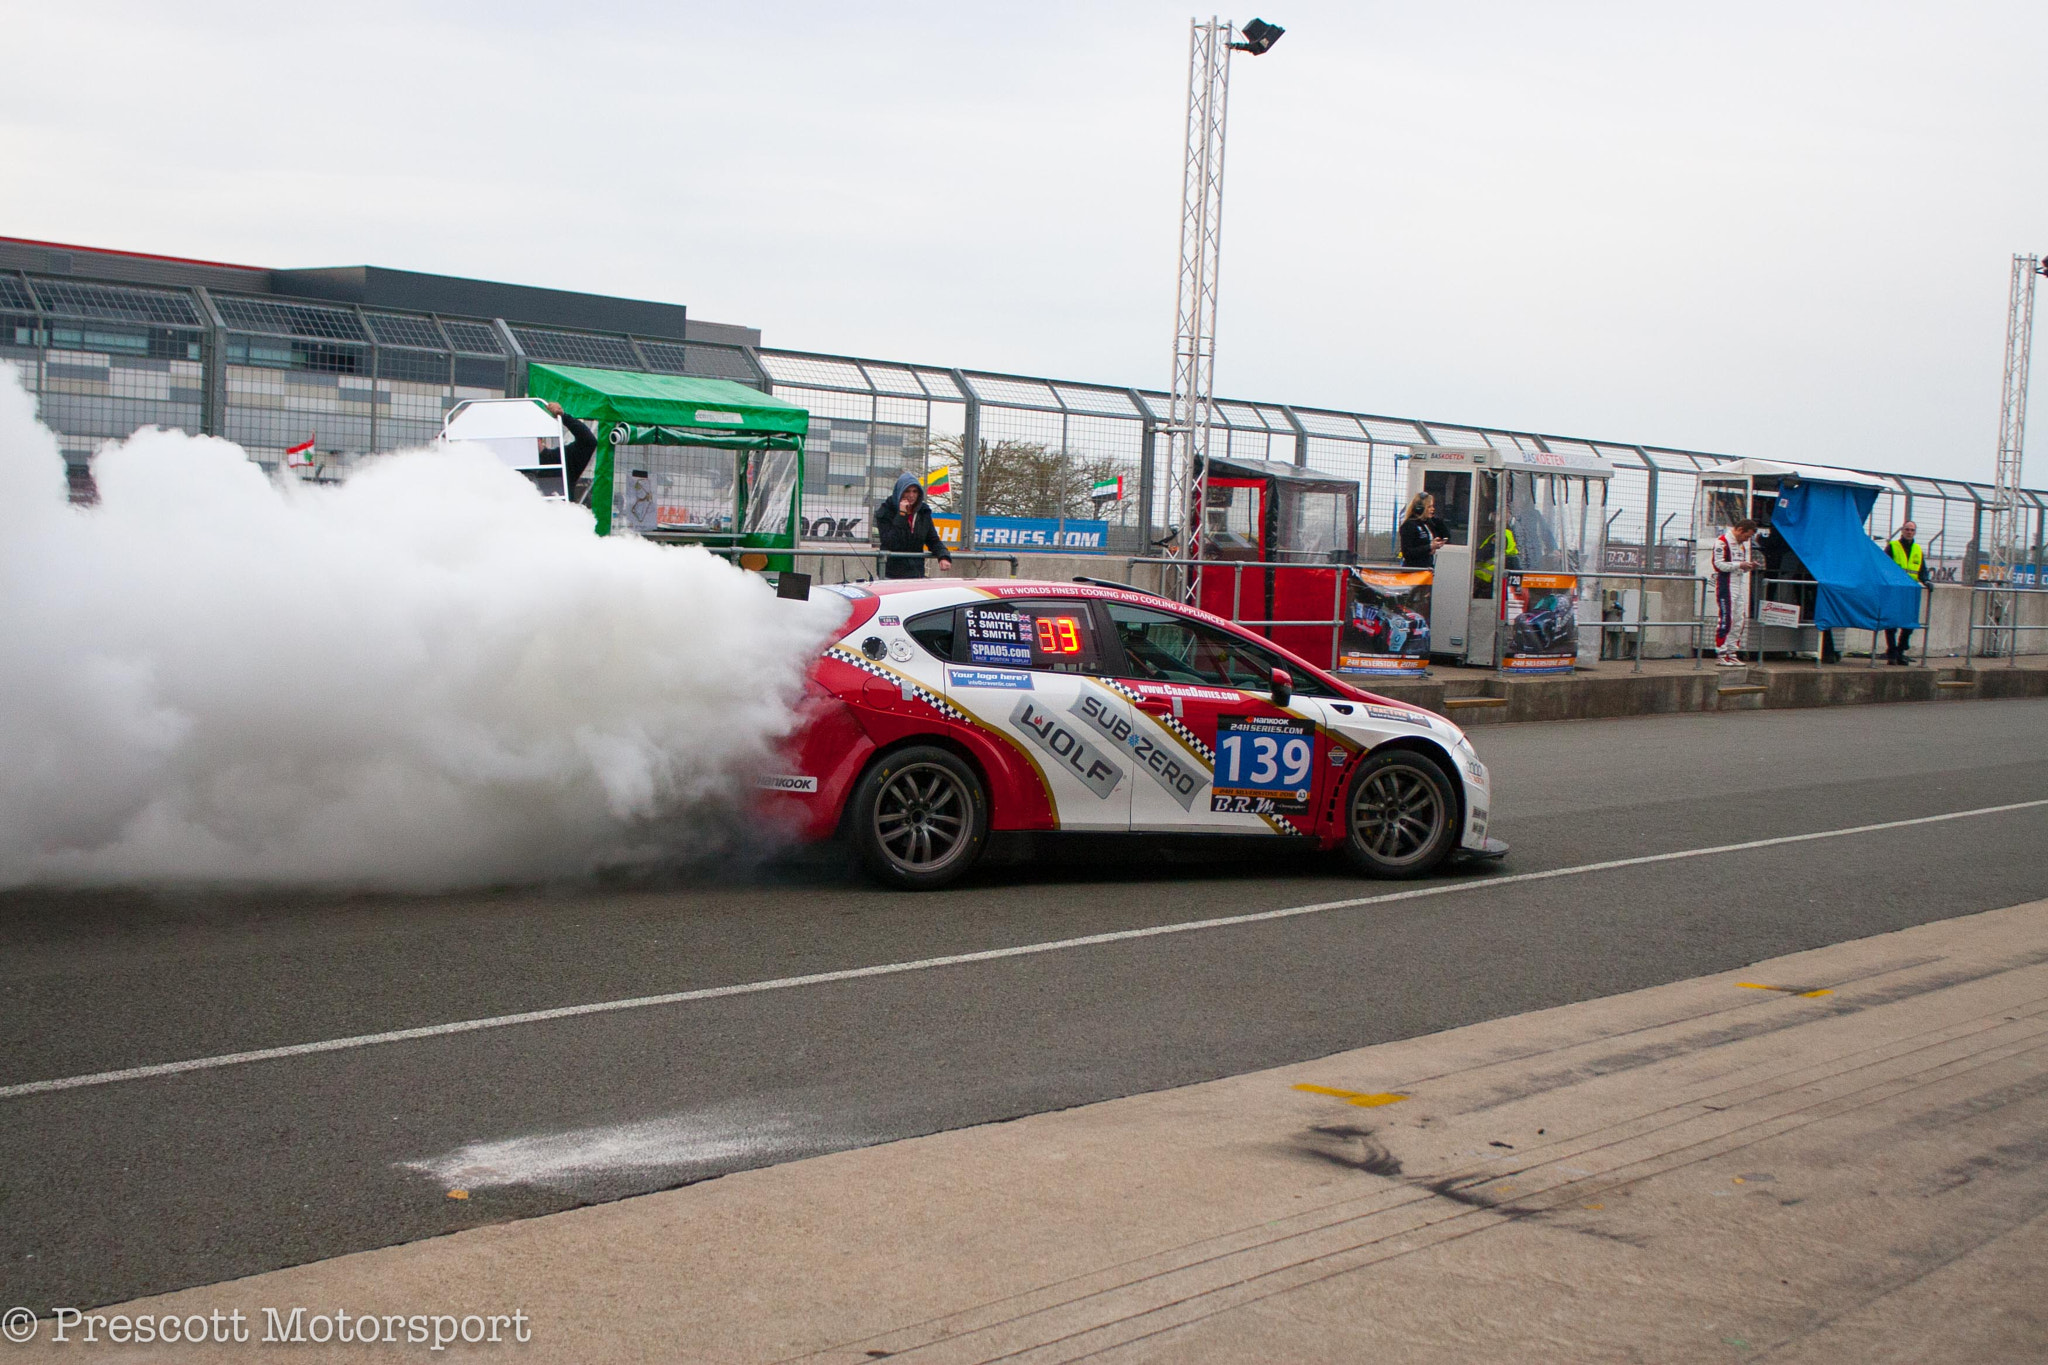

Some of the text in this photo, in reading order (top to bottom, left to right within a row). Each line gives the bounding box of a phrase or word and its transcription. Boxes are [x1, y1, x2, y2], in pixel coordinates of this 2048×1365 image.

[966, 610, 1019, 622] C. DAVIES
[998, 586, 1226, 627] THE WORLDS FINEST COOKING AND COOLING APPLIANCES
[968, 619, 1013, 631] P. SMITH
[969, 629, 1017, 640] R. SMITH
[951, 671, 1029, 681] Your logo here?
[1021, 704, 1113, 782] WOLF
[1081, 696, 1195, 795] SUB ZERO
[1222, 735, 1311, 785] 139
